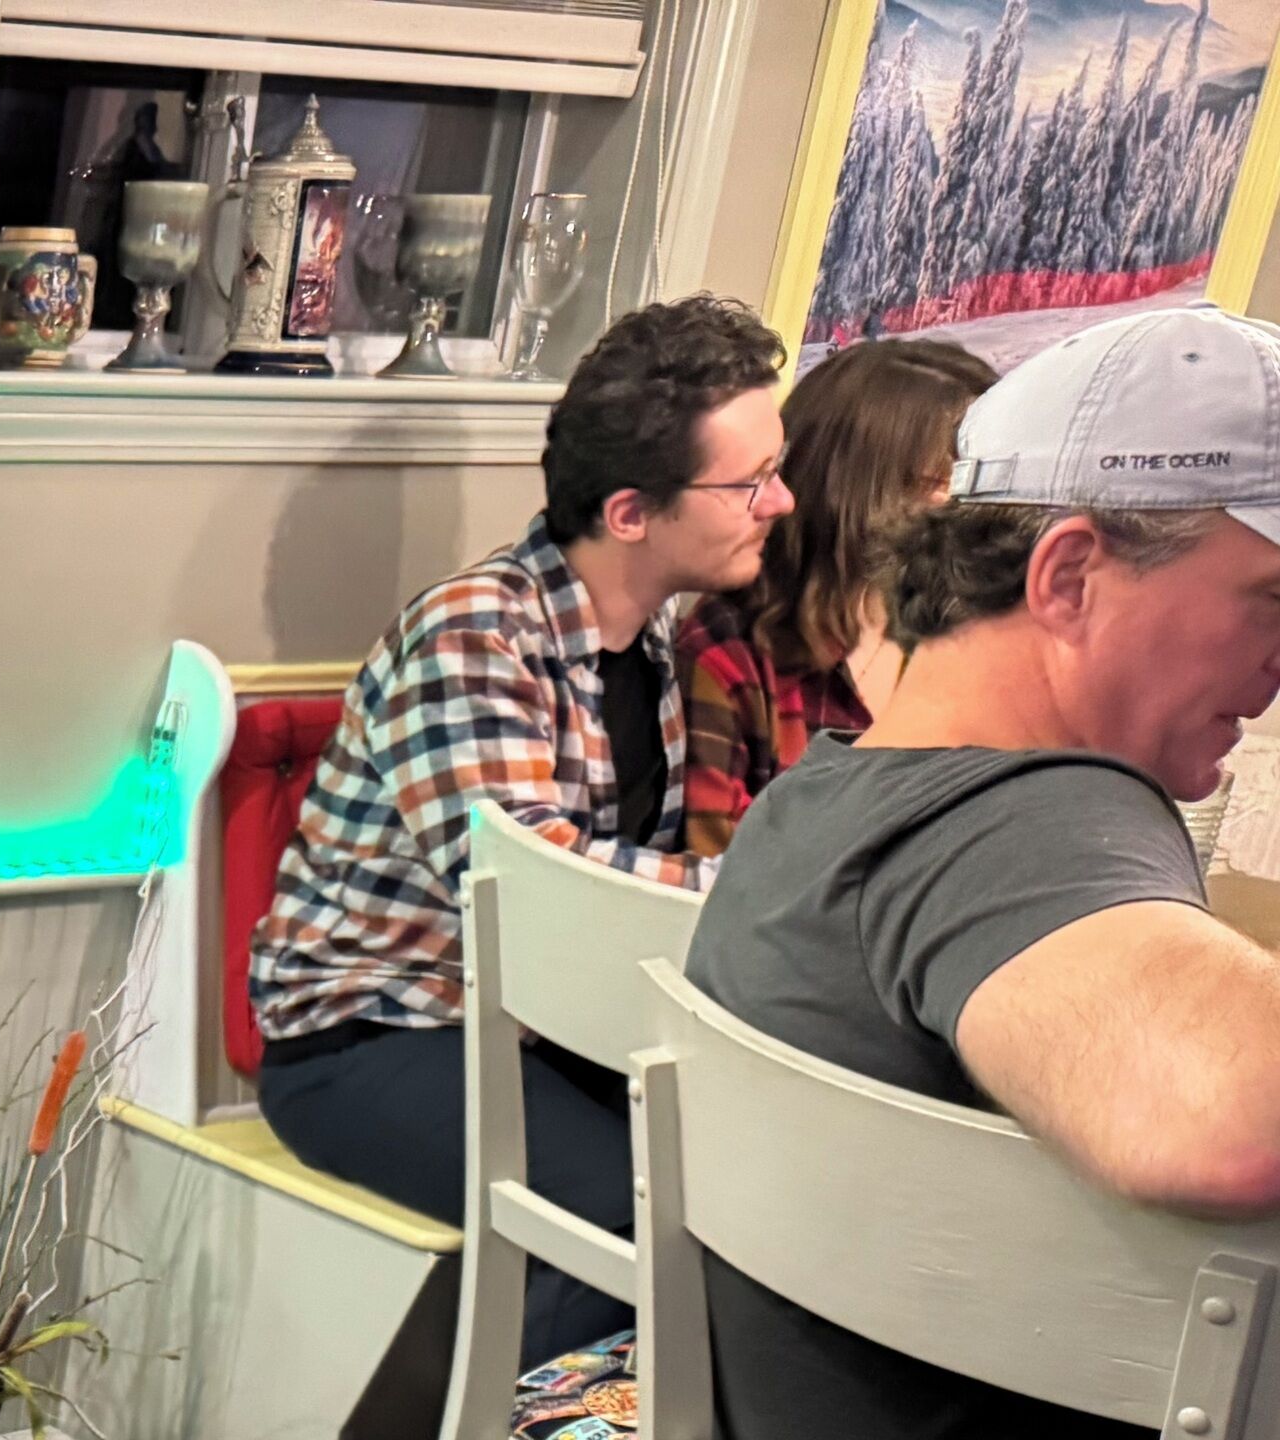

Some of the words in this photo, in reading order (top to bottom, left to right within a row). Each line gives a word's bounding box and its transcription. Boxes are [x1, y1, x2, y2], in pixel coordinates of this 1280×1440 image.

[1099, 454, 1126, 470] ON
[1130, 453, 1167, 470] THE
[1168, 451, 1230, 469] OCEAN
